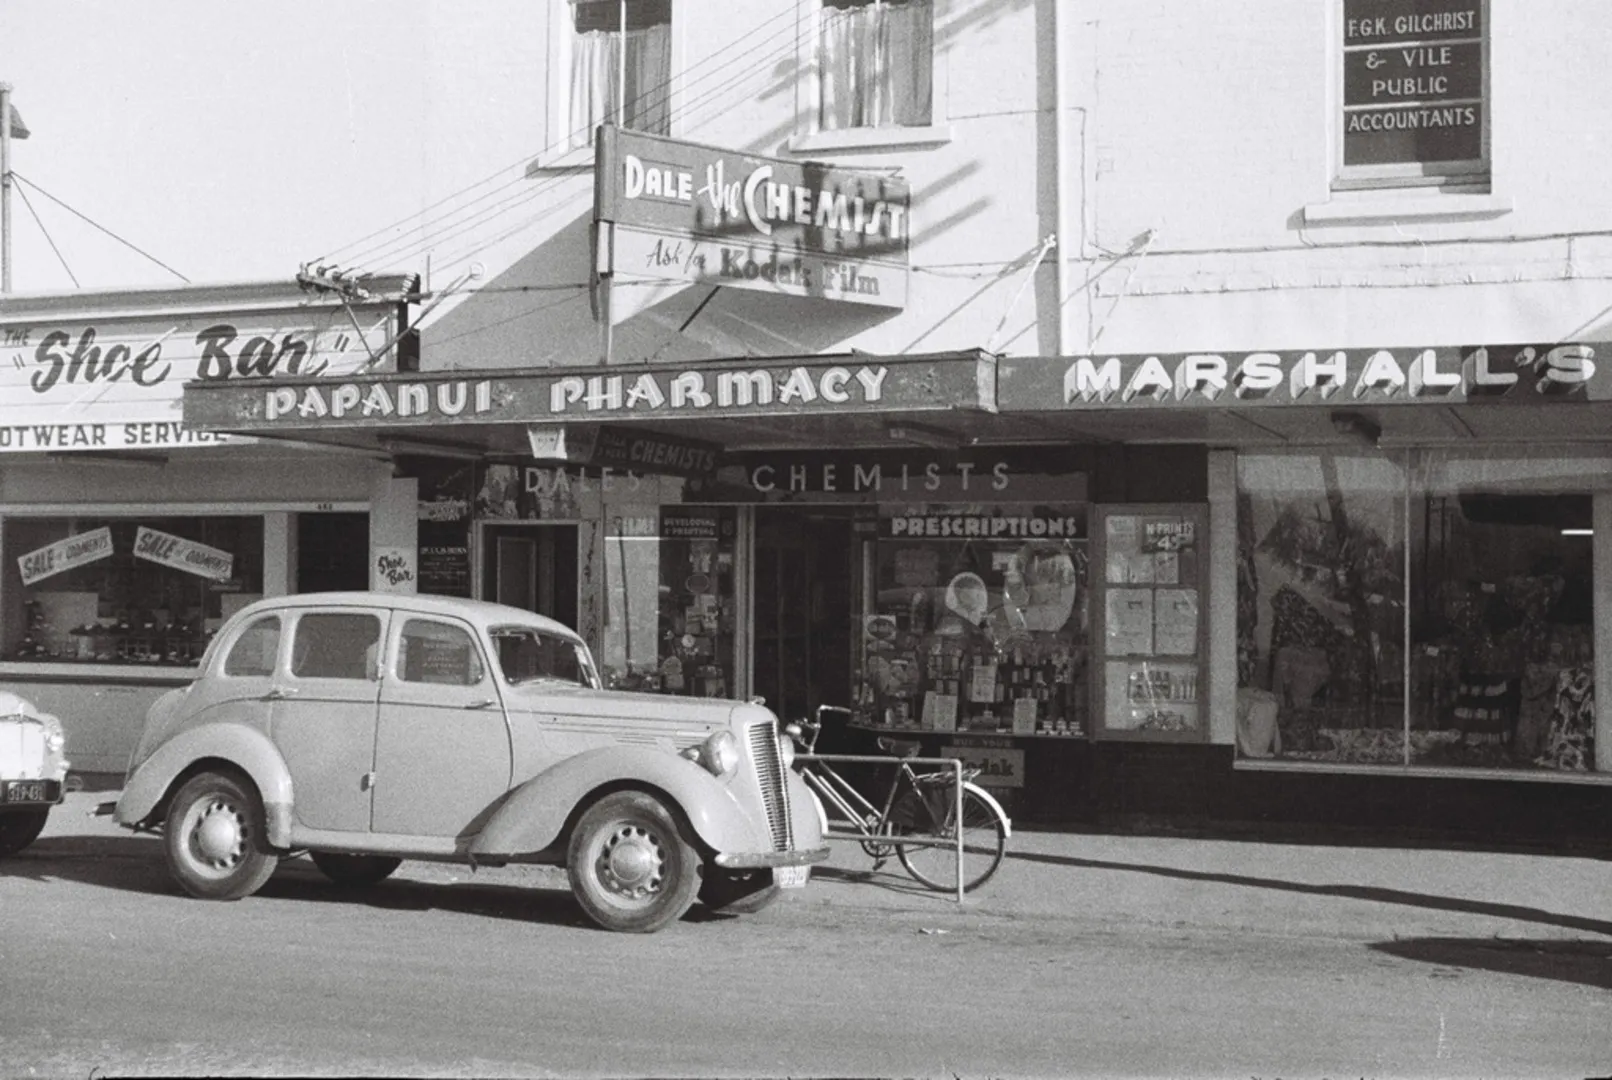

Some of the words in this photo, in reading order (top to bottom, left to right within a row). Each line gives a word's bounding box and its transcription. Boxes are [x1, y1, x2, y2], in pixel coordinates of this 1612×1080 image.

[1395, 10, 1475, 34] GILCHRIST
[1366, 52, 1387, 69] &
[1402, 47, 1451, 67] VILE
[1372, 76, 1447, 97] PUBLIC
[1348, 108, 1475, 132] ACCOUNTANTS
[625, 155, 693, 201] DALE
[743, 165, 905, 239] CHEMIST
[647, 239, 682, 269] Ask
[719, 247, 812, 287] Kodak
[1064, 344, 1596, 402] MARSHALL'S
[265, 381, 490, 420] PAPANUI
[551, 366, 888, 413] PHARMACY
[751, 462, 1011, 493] CHEMISTS
[891, 516, 1077, 537] PRESCRIPTIONS
[137, 531, 177, 560] SALE
[23, 547, 54, 579] SALE
